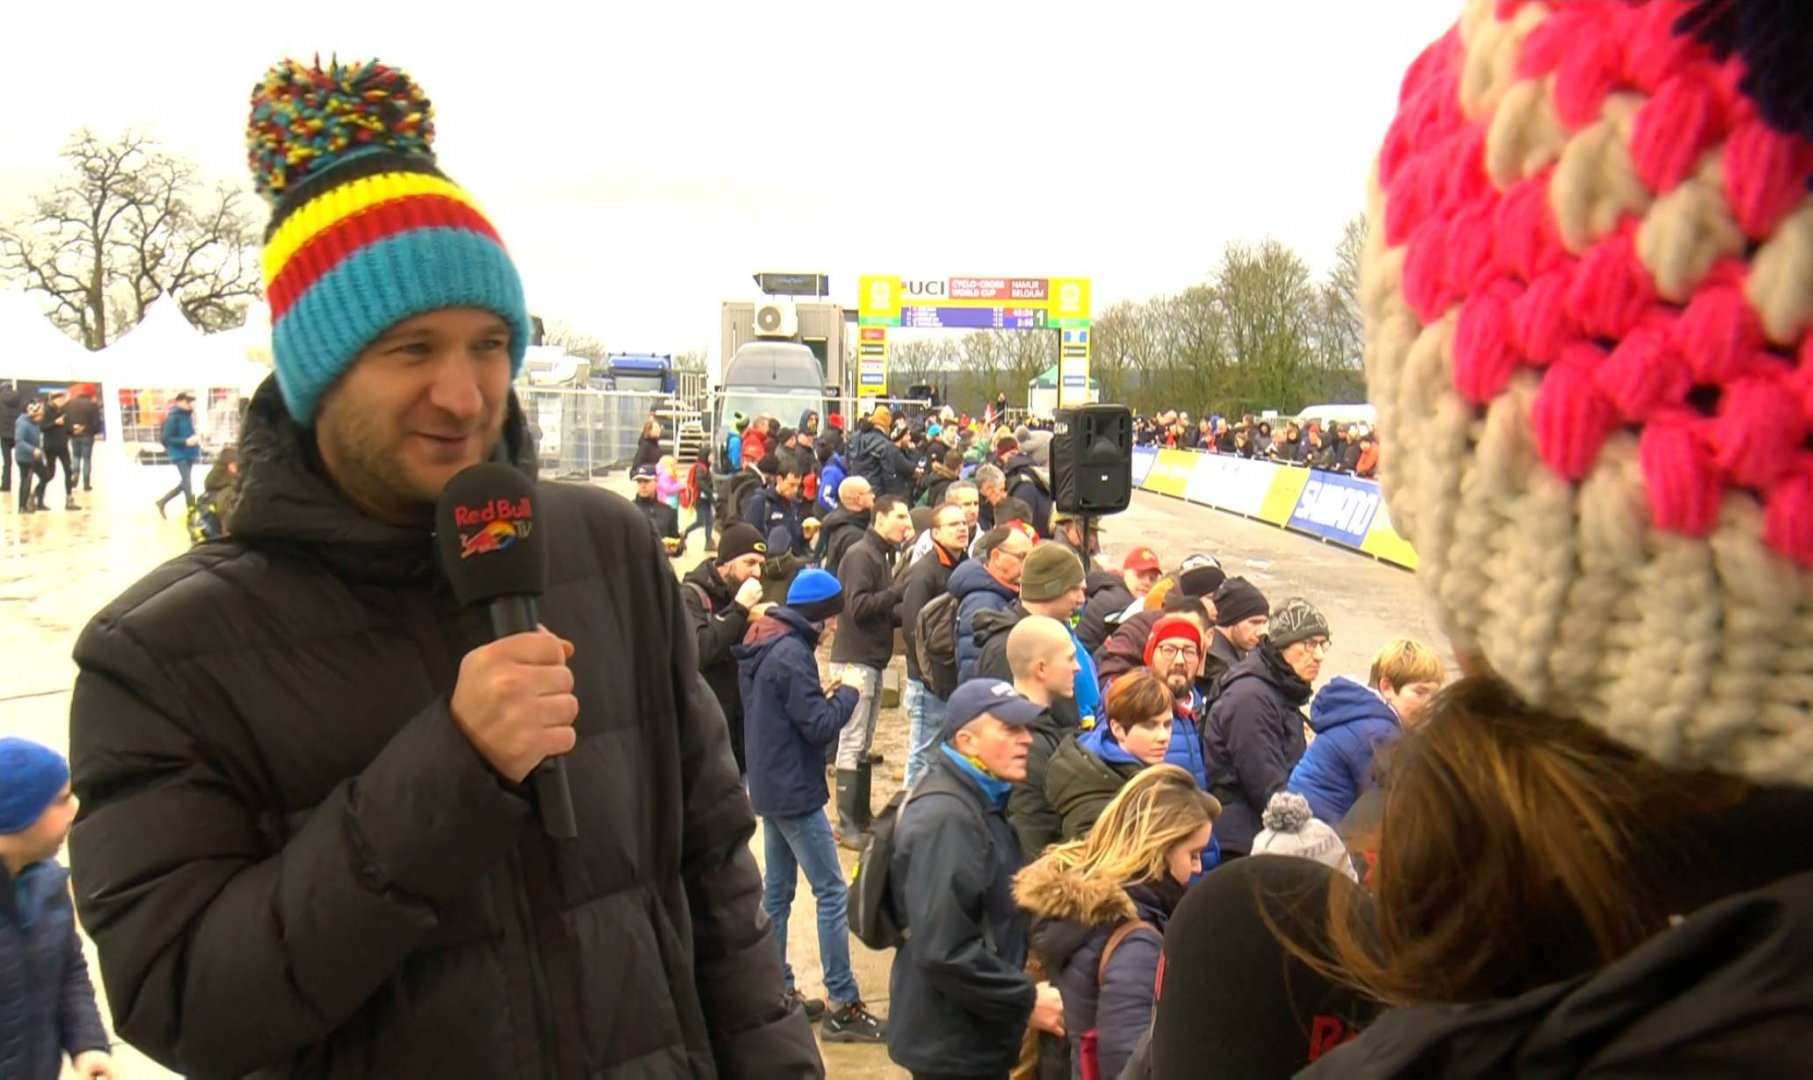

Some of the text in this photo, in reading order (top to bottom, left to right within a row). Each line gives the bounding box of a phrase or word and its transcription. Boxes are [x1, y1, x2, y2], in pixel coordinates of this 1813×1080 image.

[909, 281, 945, 295] UCI
[1011, 280, 1039, 289] NAMUR
[951, 288, 997, 298] WORLD CUP
[1011, 289, 1045, 298] BELGIUM
[1036, 310, 1044, 326] 1
[455, 496, 532, 528] Red Bull
